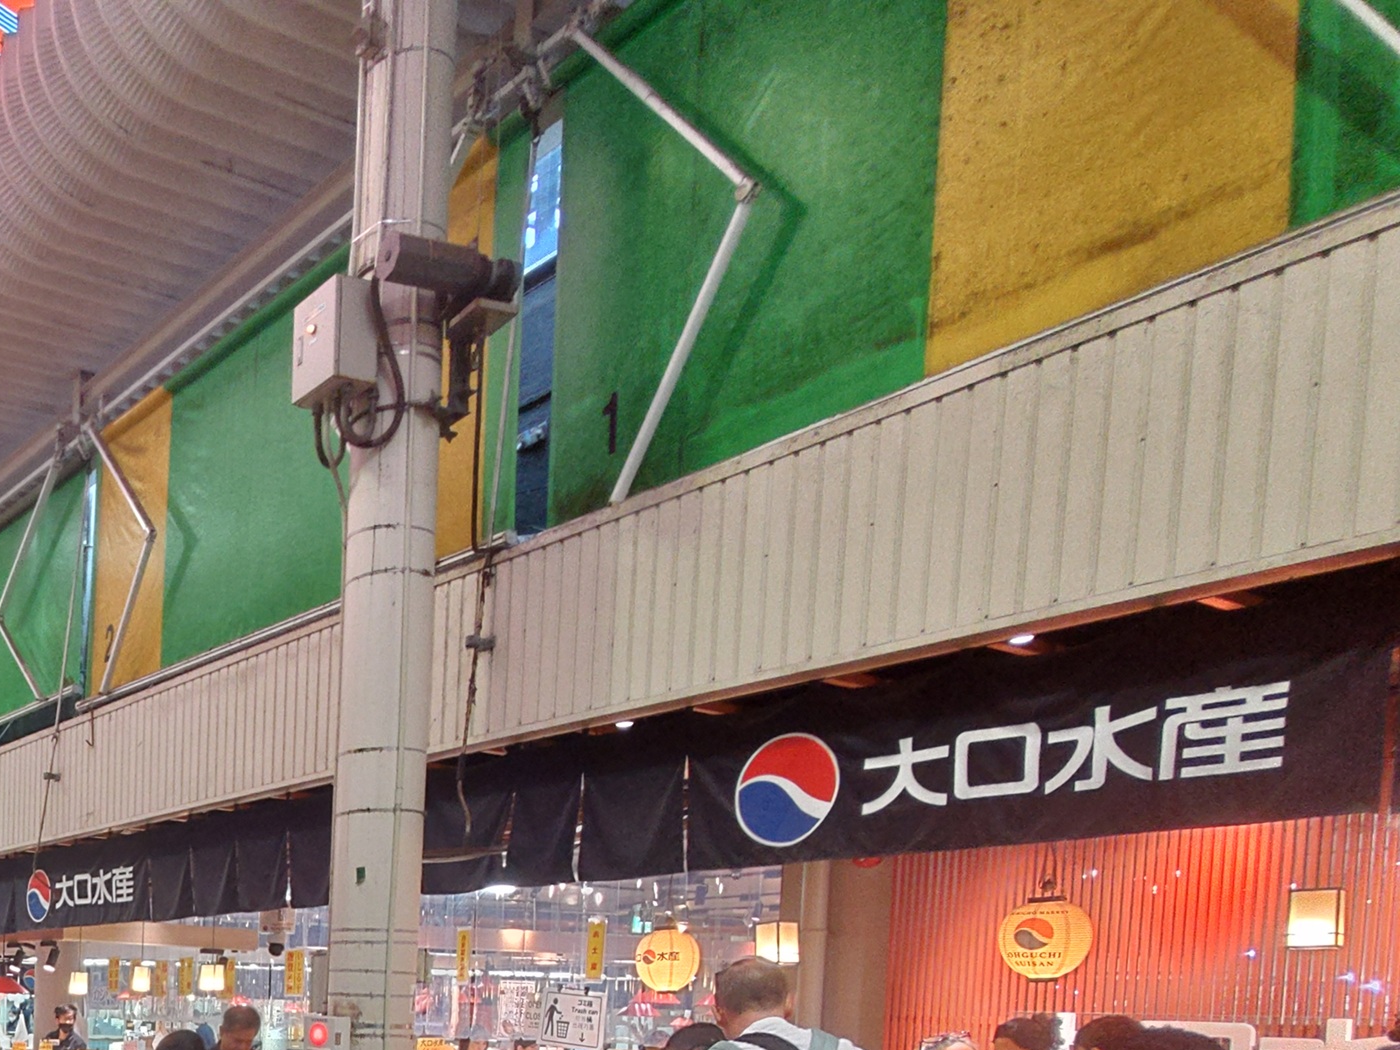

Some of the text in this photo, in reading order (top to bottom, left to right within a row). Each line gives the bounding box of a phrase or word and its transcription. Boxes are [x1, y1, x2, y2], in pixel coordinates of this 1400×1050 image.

[602, 391, 618, 455] 1
[861, 680, 1291, 816] 大口水産
[55, 866, 134, 910] 大口水産
[1007, 951, 1062, 959] OHGUCHI
[526, 1012, 541, 1020] CLOS
[571, 1006, 599, 1016] Trash can
